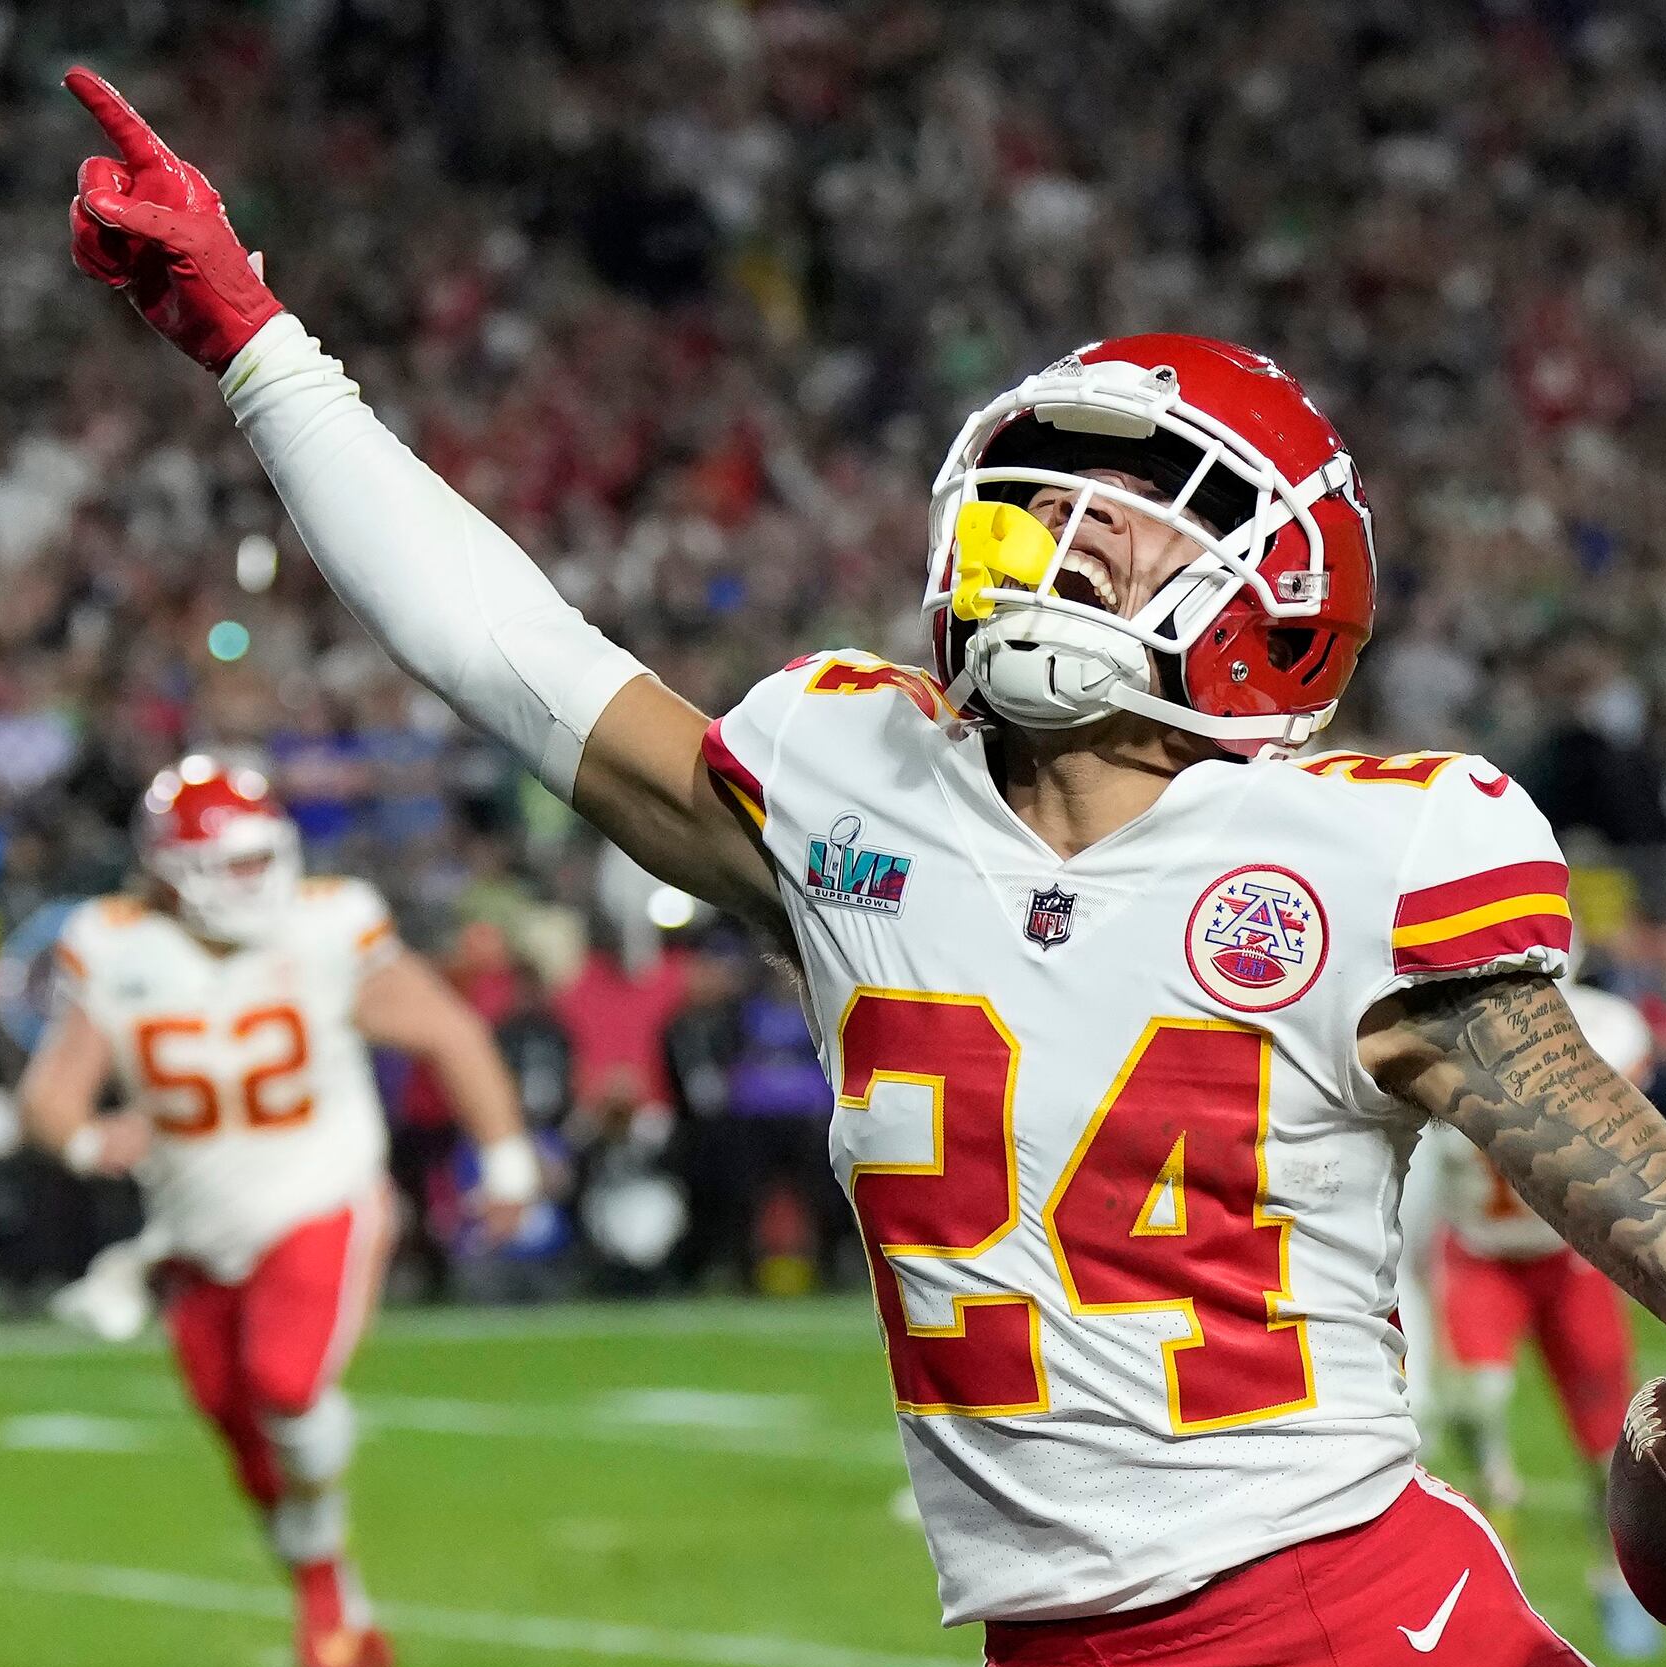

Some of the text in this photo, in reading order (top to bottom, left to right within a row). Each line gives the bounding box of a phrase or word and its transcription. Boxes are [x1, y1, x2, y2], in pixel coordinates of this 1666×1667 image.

[814, 888, 890, 909] SUPER BOWL
[1030, 910, 1065, 938] NFL
[1235, 957, 1267, 977] LH
[1507, 1008, 1531, 1034] Thy
[137, 1005, 313, 1136] 52
[838, 986, 1317, 1435] 24
